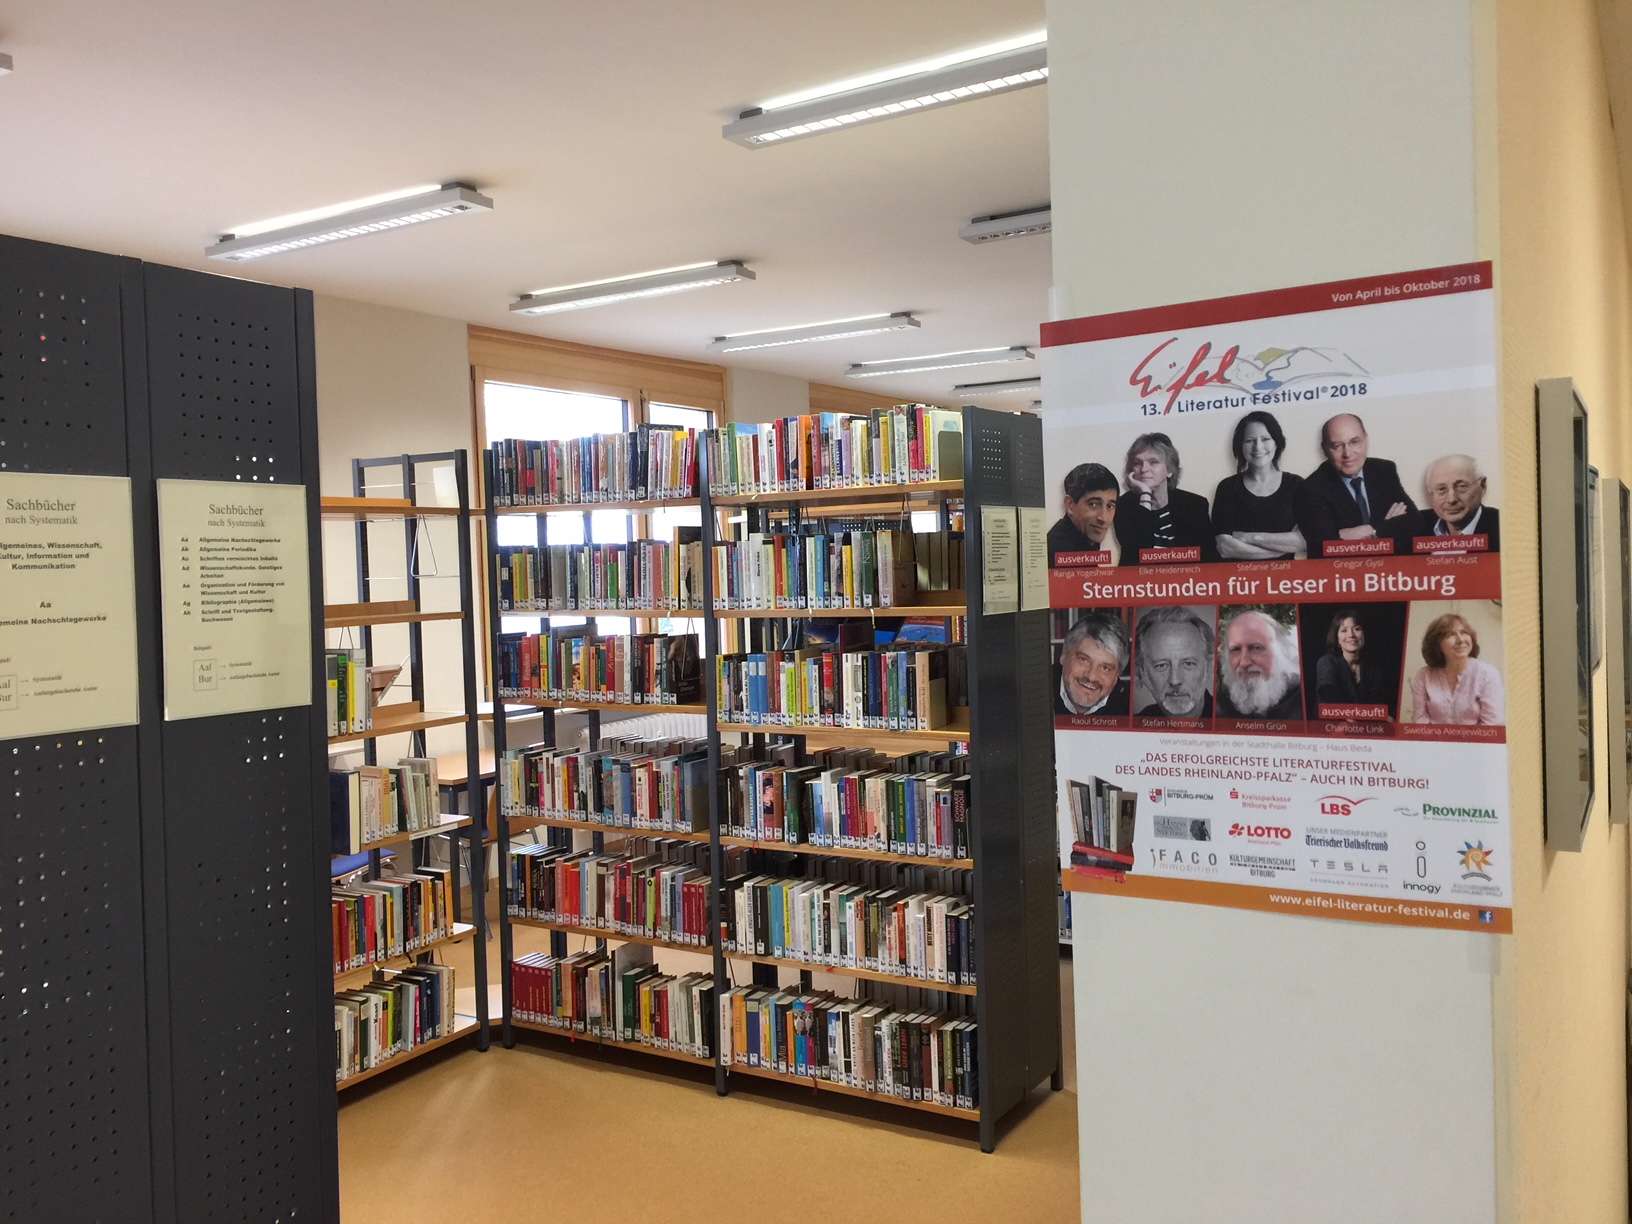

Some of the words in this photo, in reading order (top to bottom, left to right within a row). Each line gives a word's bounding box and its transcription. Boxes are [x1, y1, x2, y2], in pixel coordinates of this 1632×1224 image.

[1332, 292, 1353, 303] Von
[1355, 287, 1381, 300] April
[1384, 283, 1400, 295] bis
[1403, 278, 1450, 293] Oktober
[1453, 274, 1481, 286] 2018
[1140, 404, 1162, 416] 13.
[1177, 396, 1247, 413] Literatur
[6, 499, 76, 511] Sachbücher
[209, 503, 264, 515] Sachbücher
[5, 515, 27, 524] nach
[29, 515, 78, 526] Systematik
[207, 519, 225, 527] nach
[226, 519, 266, 528] Systematik
[47, 542, 102, 550] Wissenschaft,
[1326, 542, 1390, 553] ausverkauft!
[1416, 538, 1485, 550] ausverkauft!
[1057, 554, 1109, 564] ausverkauft!
[1142, 550, 1198, 561] ausverkauft!
[1426, 556, 1456, 566] Stefan
[1457, 555, 1478, 565] Aust
[1236, 563, 1268, 572] Stefanie
[1270, 562, 1291, 571] Stahl
[1333, 560, 1363, 569] Gregor
[1365, 559, 1384, 569] Gysi
[1053, 570, 1076, 579] Ranga
[1076, 569, 1114, 579] Yogeshwar
[1139, 567, 1154, 575] Elke
[1155, 565, 1201, 575] Heidenreich
[1082, 577, 1221, 599] Sternstunden
[1227, 576, 1260, 595] für
[1266, 576, 1328, 595] Leser
[1335, 574, 1356, 592] in
[1364, 572, 1456, 596] Bitburg
[31, 615, 107, 625] Nachschlagewerke
[198, 663, 212, 671] Aal
[198, 675, 212, 683] Bur
[1321, 708, 1385, 718] ausverkauft!
[1071, 717, 1091, 725] Raoul
[1092, 718, 1117, 726] Schrott
[1142, 719, 1166, 727] Stefan
[1166, 719, 1204, 729] Hertmans
[1235, 721, 1265, 730] Anselm
[1266, 722, 1287, 730] Grün
[1325, 724, 1364, 733] Charlotte
[1366, 724, 1384, 734] Link
[1404, 726, 1442, 736] Swetlana
[1442, 726, 1498, 737] Alexijewitsch
[1159, 738, 1221, 748] Veranstaltungen
[1232, 740, 1245, 748] der
[1246, 741, 1286, 749] Stadthalle
[1287, 742, 1318, 751] Bitburg
[1140, 753, 1168, 763] „DAS
[1170, 753, 1269, 767] ERFOLGREICHSTE
[1272, 758, 1396, 773] LITERATURFESTIVAL
[1115, 764, 1135, 775] DES
[1138, 766, 1181, 777] LANDES
[1309, 774, 1346, 785] AUCH
[1350, 776, 1364, 786] IN
[1368, 777, 1429, 790] BITBURG!
[1167, 792, 1214, 801] BITBURG-PRÜM
[1241, 794, 1291, 803] Kreissparkasse
[1320, 802, 1352, 816] LBS
[1422, 803, 1498, 820] PROVINZIAL
[1246, 825, 1292, 840] LOTTO
[1305, 827, 1329, 835] UNSER
[1329, 828, 1388, 838] MEDIENPARTNER
[1305, 835, 1343, 849] Trierischer
[1344, 837, 1388, 852] Volksfreund
[1229, 854, 1296, 867] KULTURGEMEINSCHAFT
[1250, 869, 1276, 878] BITBURG
[1402, 881, 1441, 894] innogy
[1269, 891, 1471, 922] www.eifel-literatur-festival.de
[779, 1045, 787, 1062] Mia
